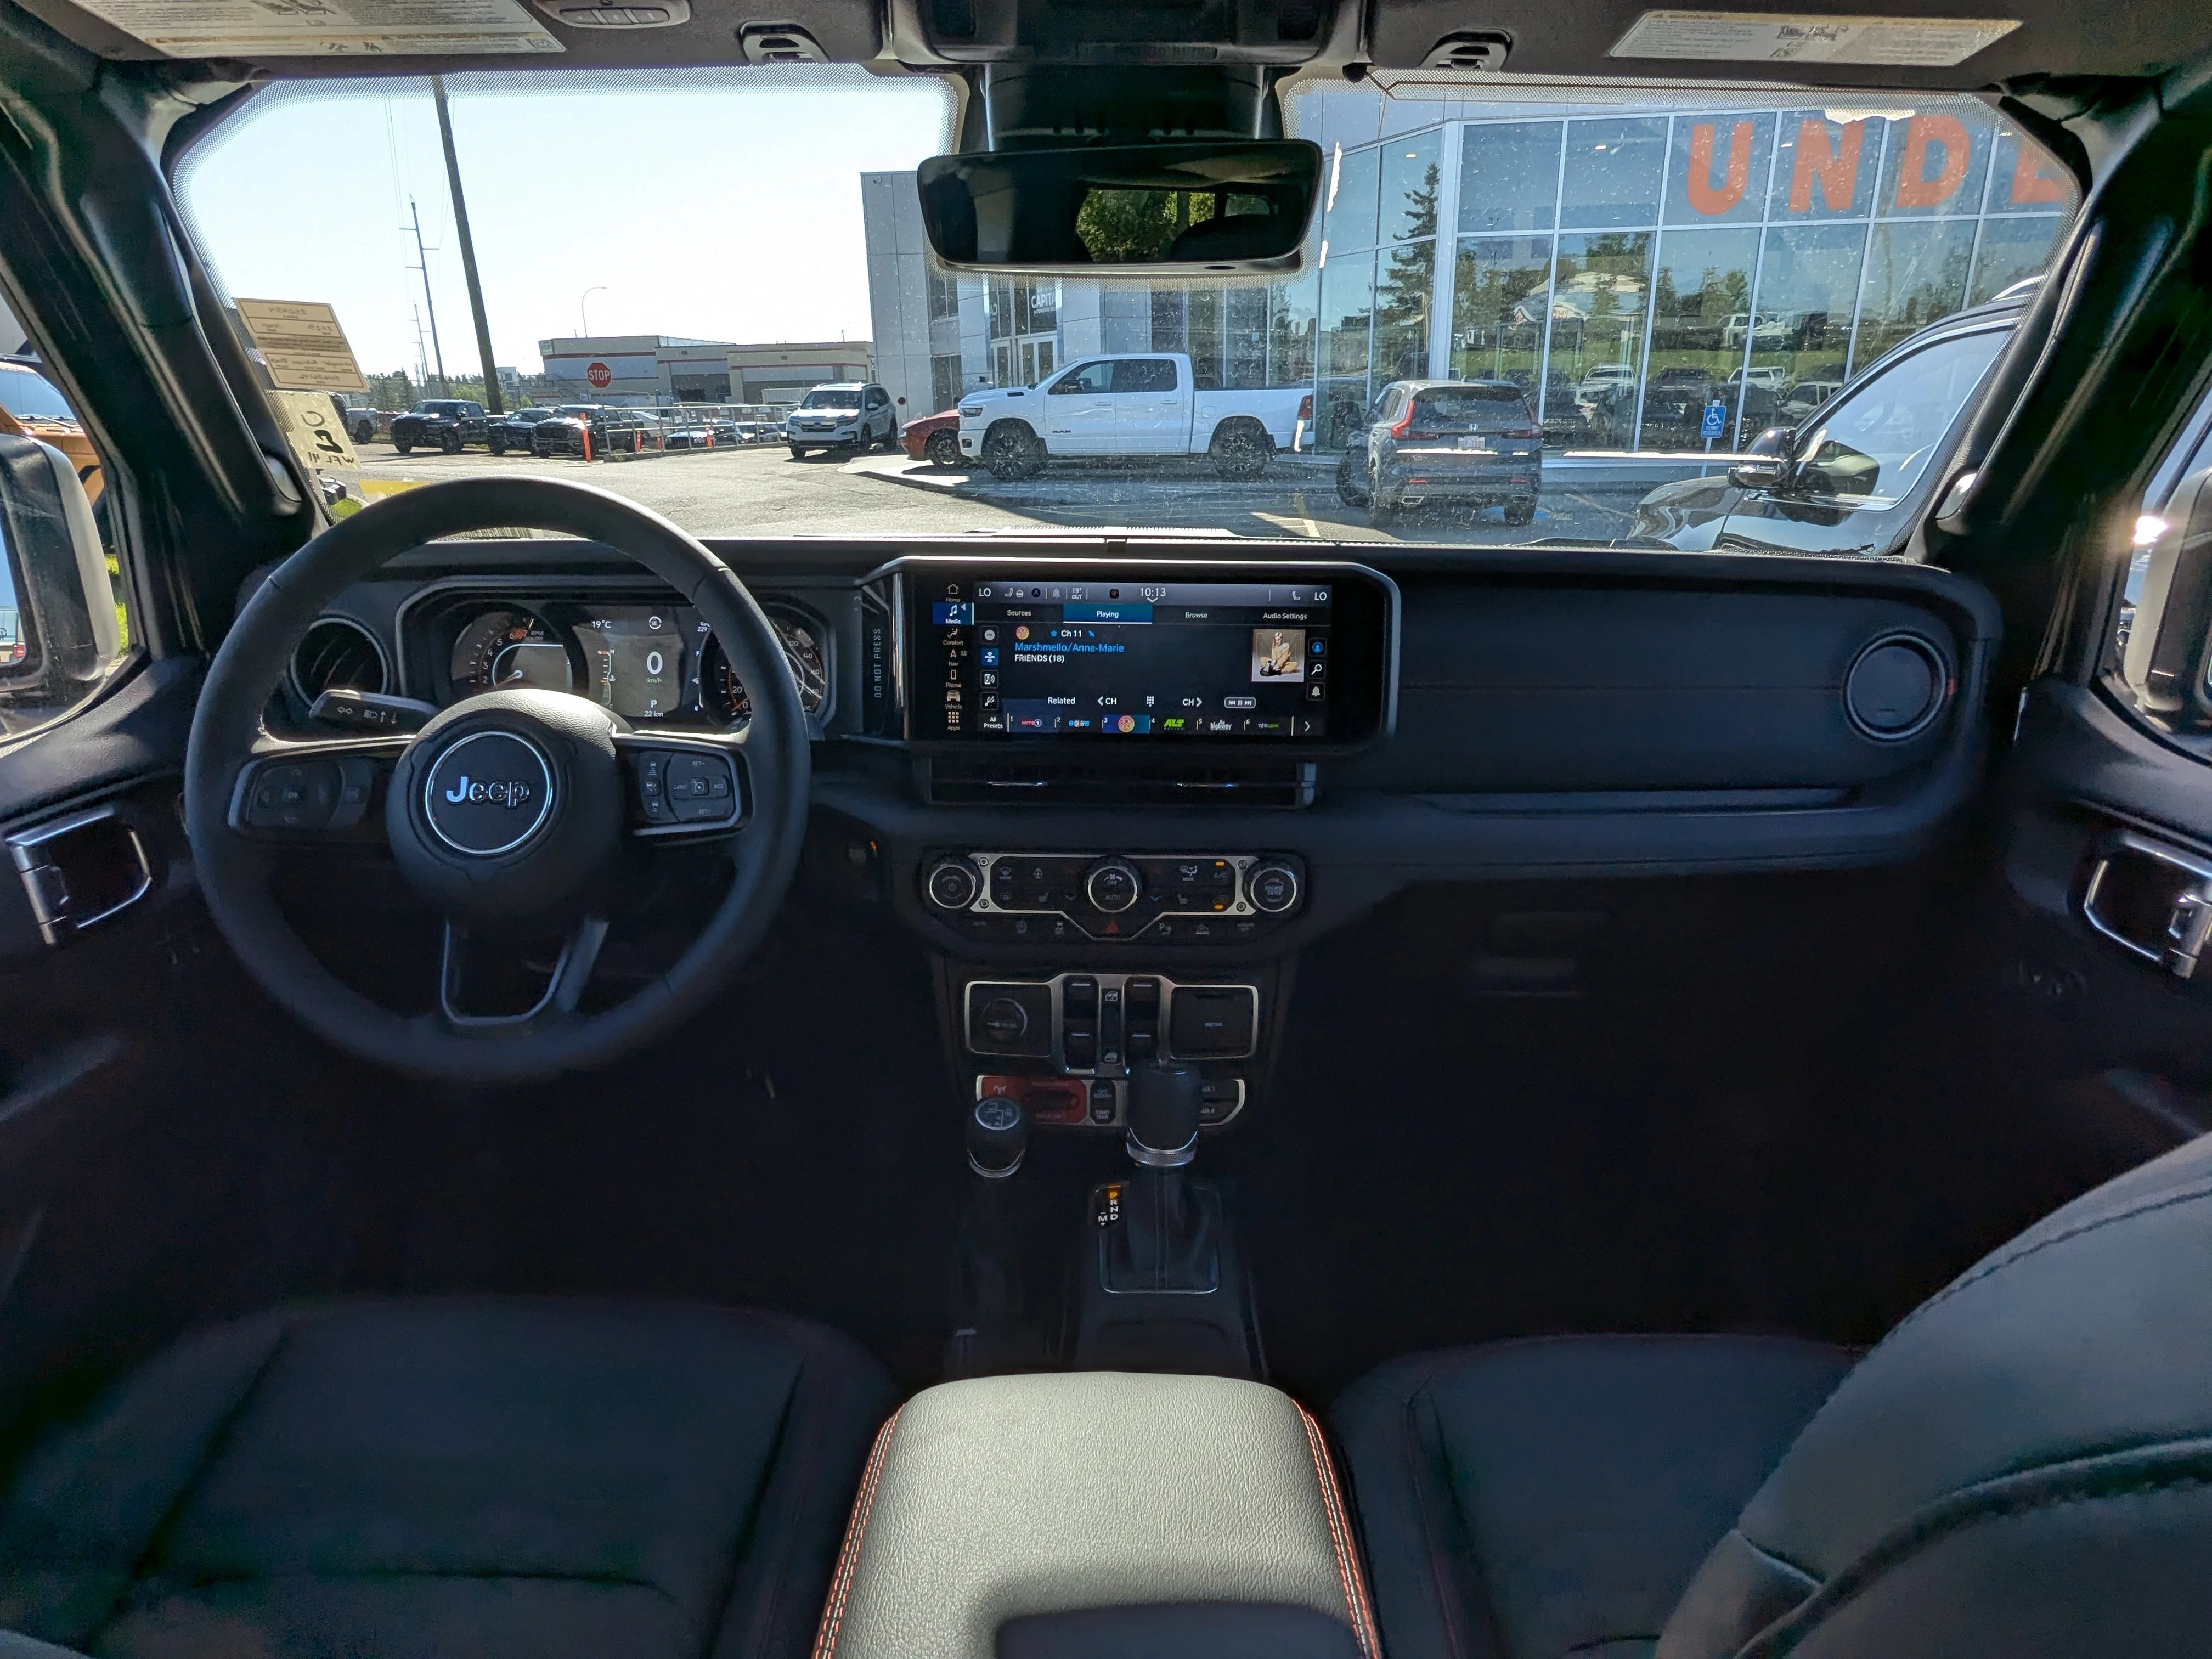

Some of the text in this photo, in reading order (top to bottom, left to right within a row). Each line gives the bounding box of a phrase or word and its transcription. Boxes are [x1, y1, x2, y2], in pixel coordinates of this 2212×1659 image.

[588, 370, 610, 380] STOP
[979, 588, 991, 597] LO
[1140, 588, 1166, 597] 10:13
[1314, 591, 1327, 601] LO
[1015, 642, 1125, 653] Marshmello/Anne-Marie
[647, 651, 663, 675] 0
[1014, 654, 1065, 663] FRIENDS (18)
[651, 699, 657, 708] P
[1164, 719, 1184, 727] ALT
[446, 775, 531, 809] Jeep
